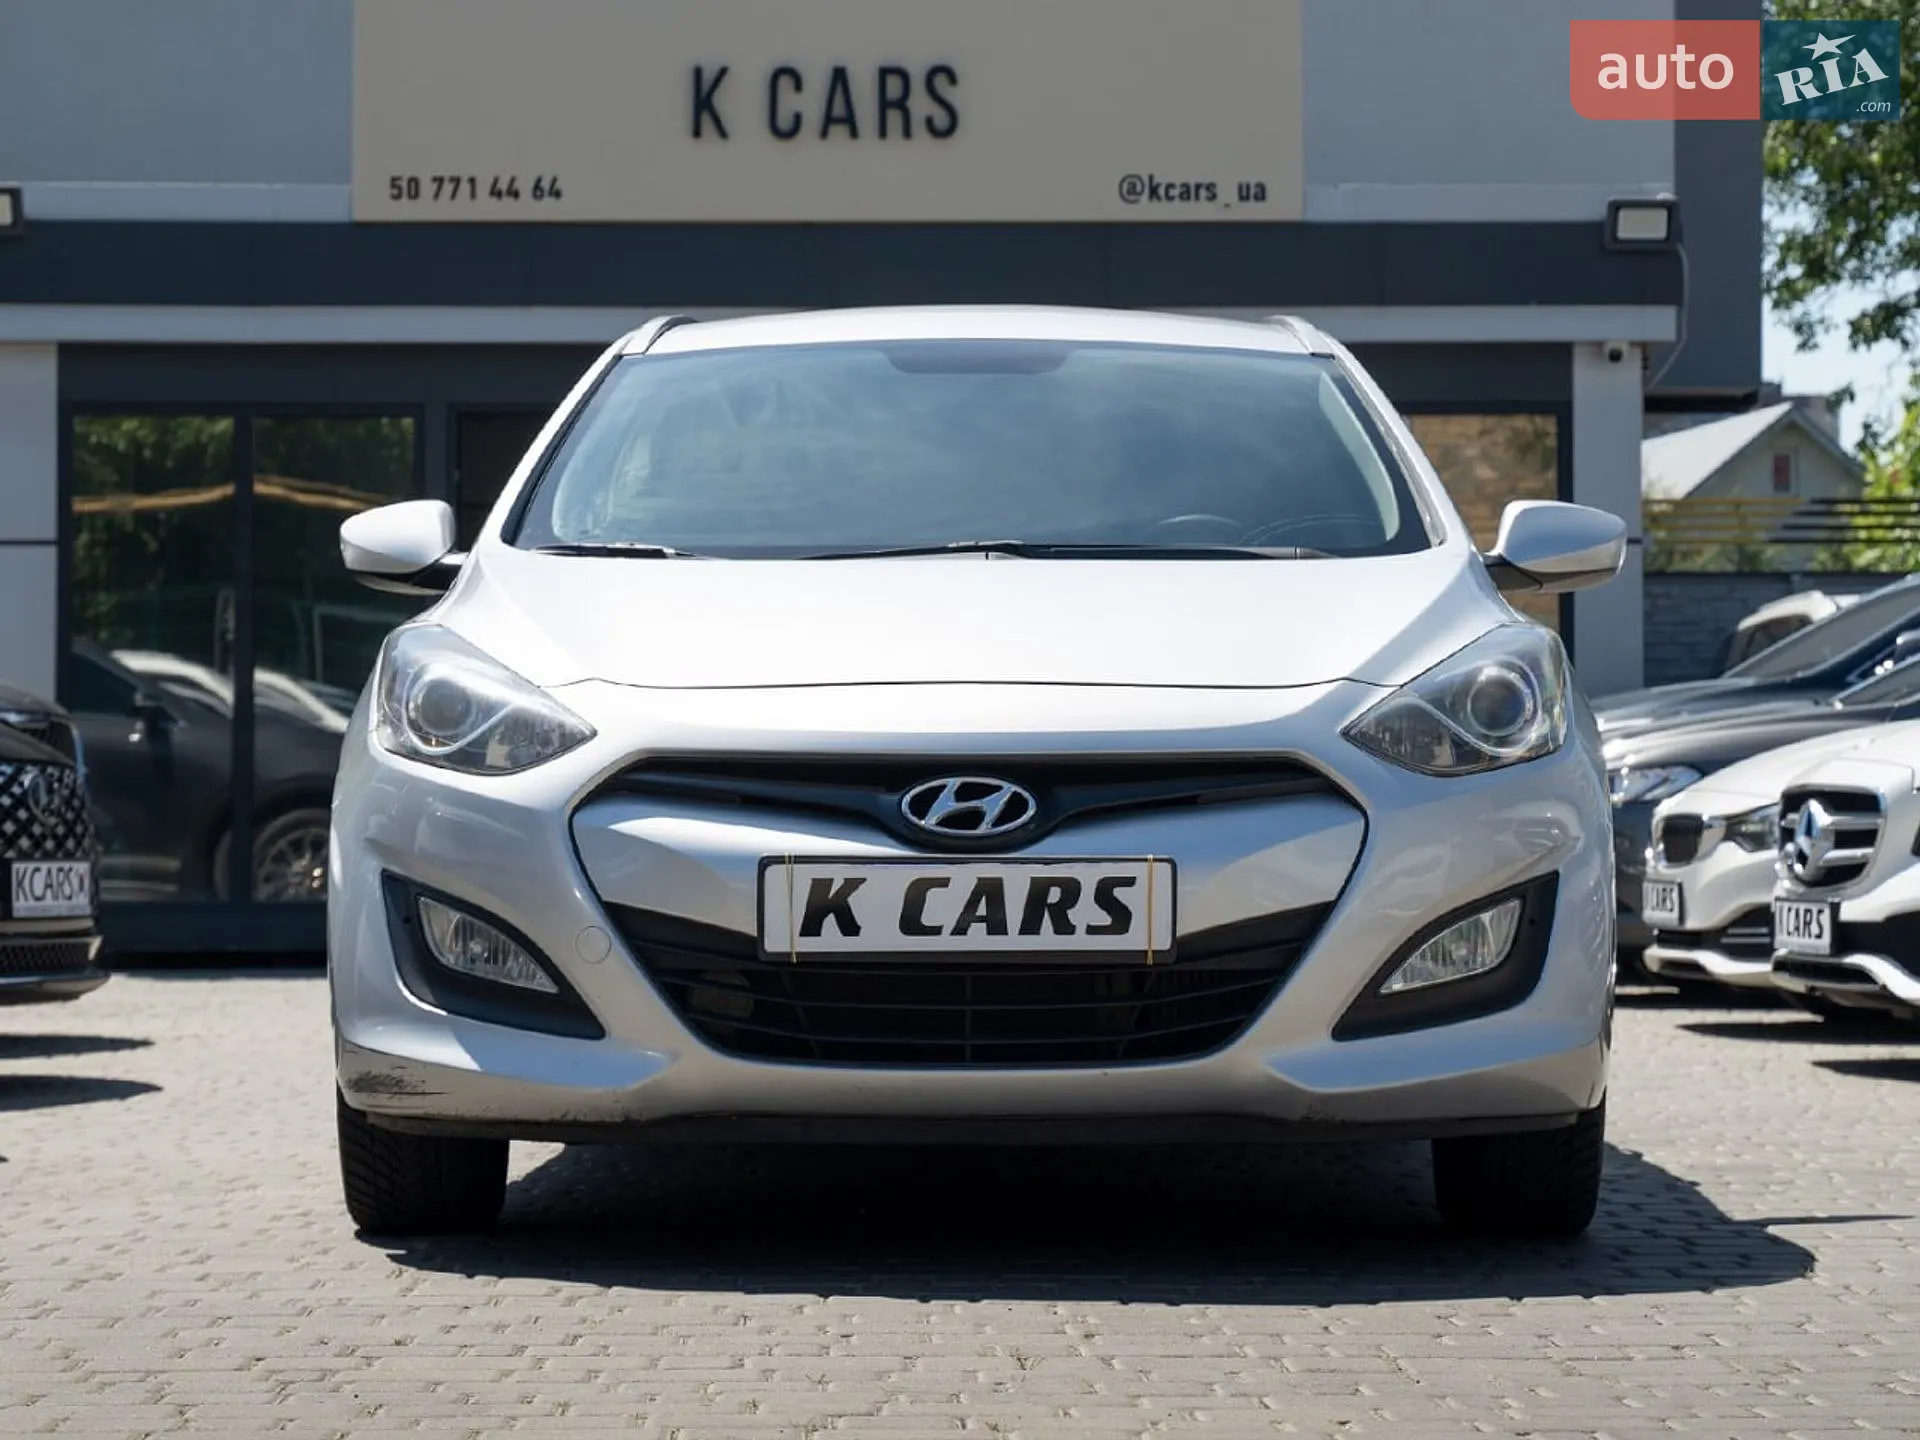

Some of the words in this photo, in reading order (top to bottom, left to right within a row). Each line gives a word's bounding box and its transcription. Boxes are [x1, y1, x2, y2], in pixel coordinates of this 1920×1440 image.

[691, 65, 730, 140] K
[767, 65, 960, 141] CARS
[389, 175, 421, 201] 50
[431, 175, 477, 201] 771
[488, 175, 521, 201] 44
[531, 175, 563, 201] 64
[799, 877, 868, 938] K
[898, 876, 1137, 937] CARS
